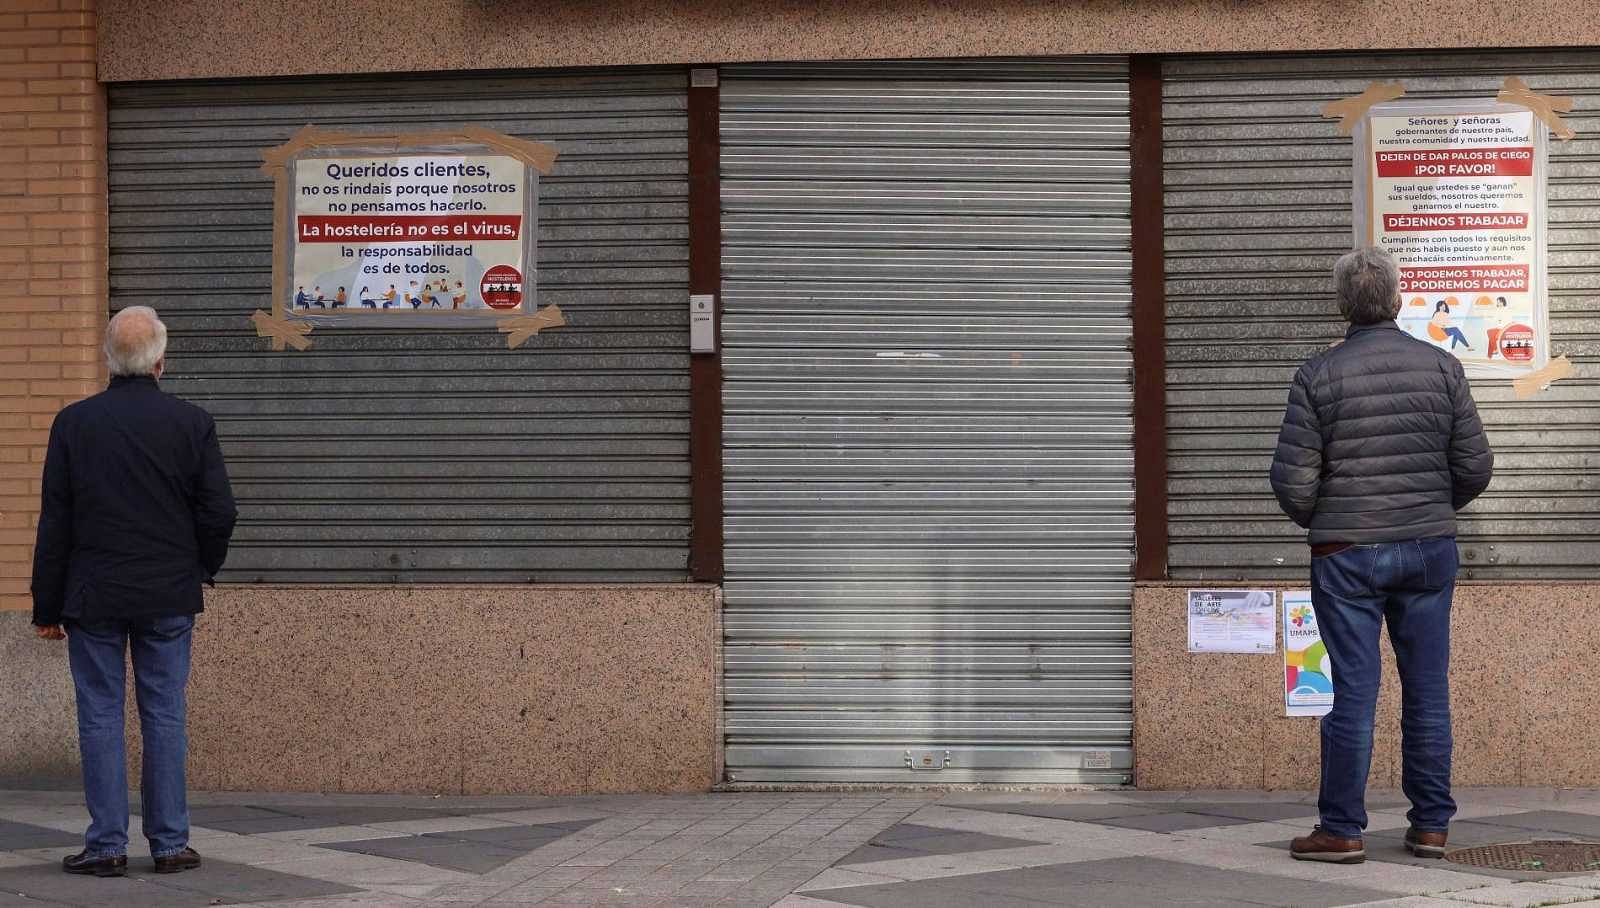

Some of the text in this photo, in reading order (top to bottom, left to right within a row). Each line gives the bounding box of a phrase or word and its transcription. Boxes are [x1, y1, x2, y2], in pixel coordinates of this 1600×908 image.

[1408, 117, 1448, 126] Señores
[1462, 117, 1500, 125] señoras
[326, 162, 490, 180] Queridos clientes,
[1415, 164, 1495, 175] ¡POR FAVOR!
[302, 183, 516, 198] no os rindais porque nosotros
[1394, 184, 1415, 193] Igual
[329, 200, 486, 215] no pensamos hacerlo.
[1389, 215, 1523, 227] DÉJENNOS TRABAJAR
[303, 222, 516, 238] La hostelería no es el virus,
[1382, 236, 1429, 245] Cumplimos
[1490, 235, 1531, 243] requisitos
[342, 245, 472, 260] la responsabilidad
[1424, 245, 1451, 253] habéis
[1400, 254, 1444, 262] machacáis
[364, 262, 450, 274] es de todos.
[1472, 269, 1526, 278] TRABAJAR,
[1400, 279, 1524, 290] O PODREMOS PAGAR
